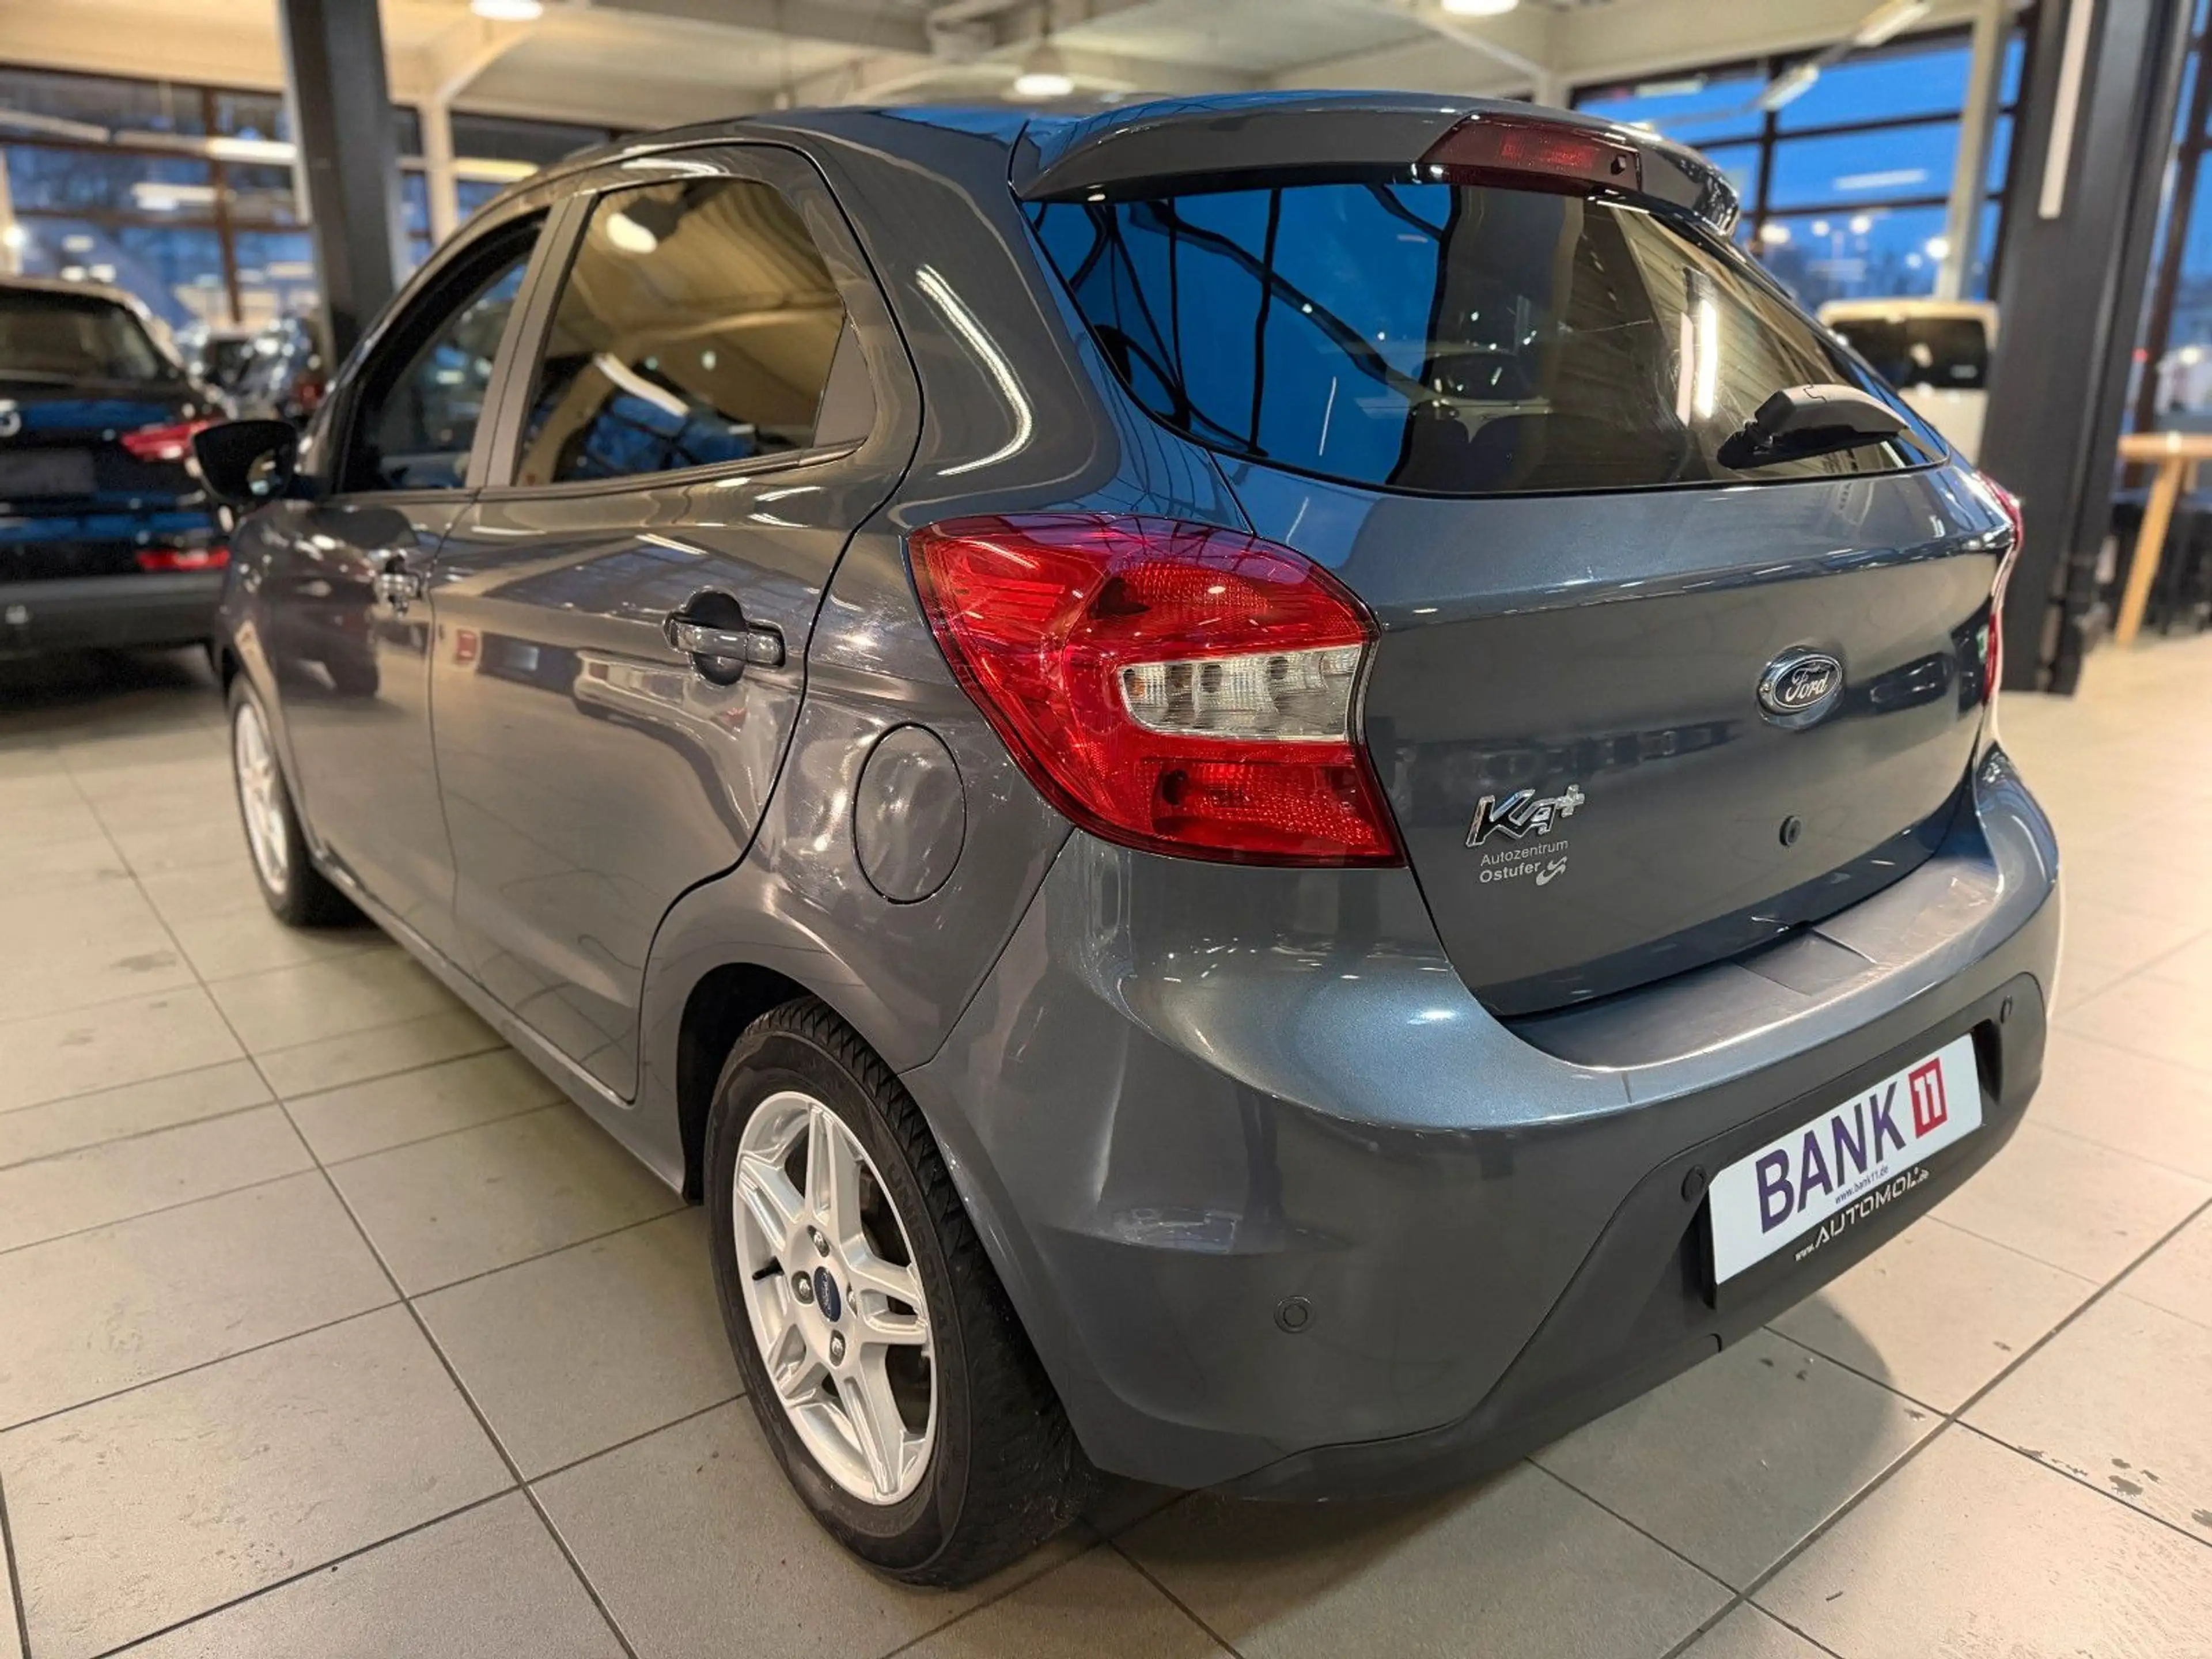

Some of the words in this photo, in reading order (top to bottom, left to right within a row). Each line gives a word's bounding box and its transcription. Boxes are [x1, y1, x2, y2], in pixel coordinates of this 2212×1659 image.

[1785, 663, 1831, 702] Ford
[1479, 861, 1541, 883] Ostufer
[1480, 840, 1569, 867] Autozentrum
[1755, 1081, 1907, 1234] BANK
[1835, 1165, 1889, 1205] www.bank11.de
